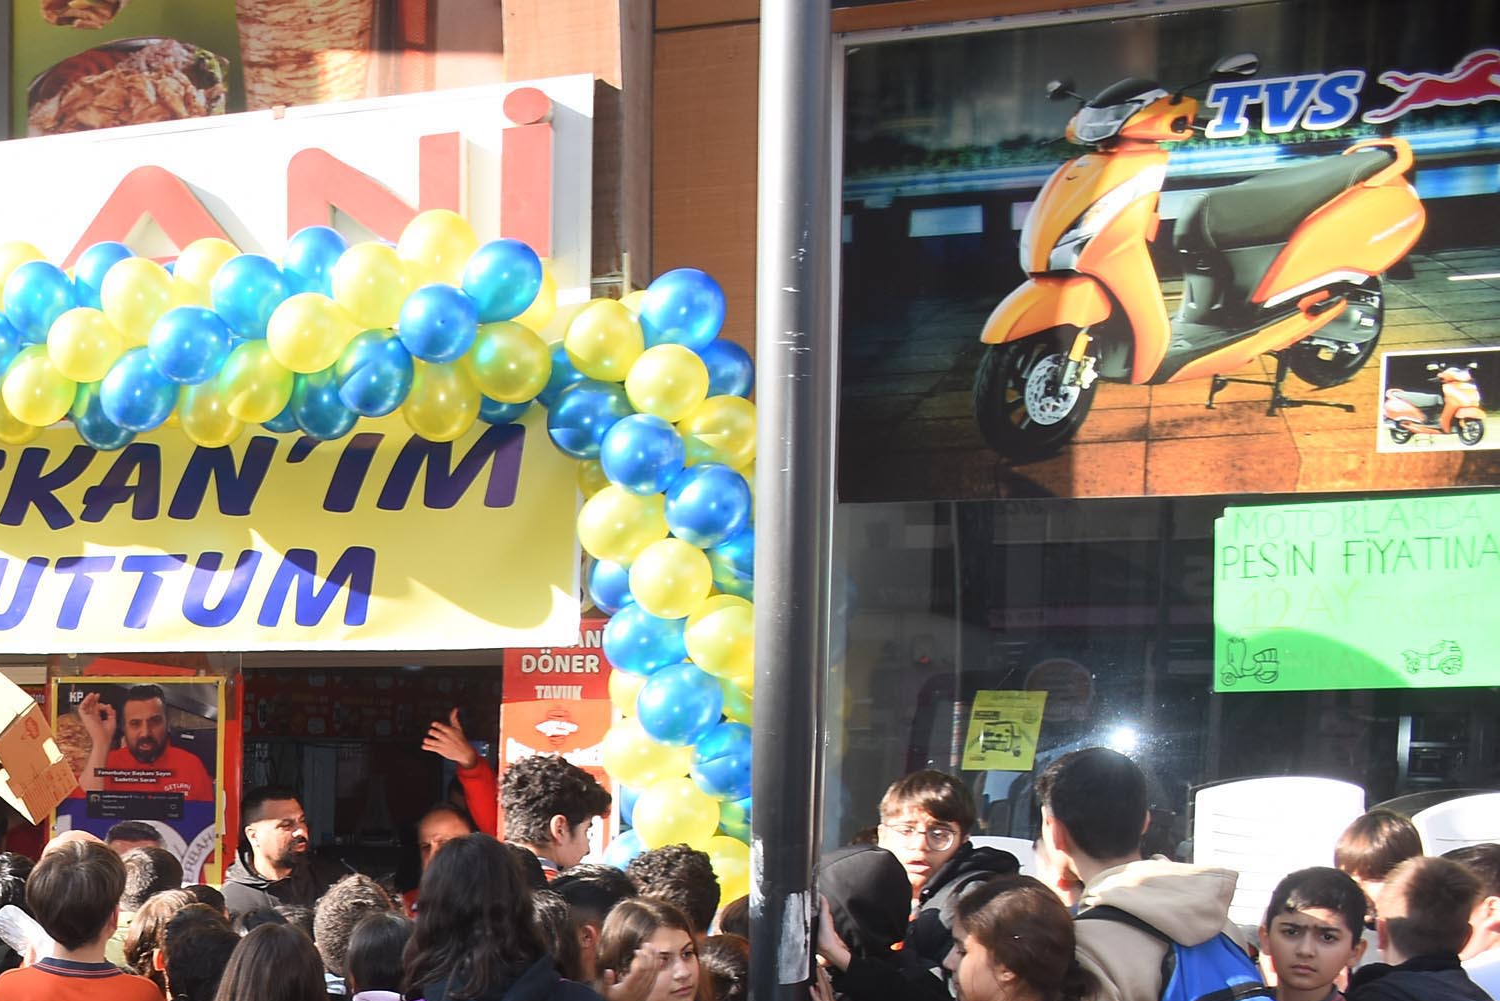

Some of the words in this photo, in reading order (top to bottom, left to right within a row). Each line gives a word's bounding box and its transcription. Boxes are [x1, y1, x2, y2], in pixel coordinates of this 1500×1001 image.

[1206, 71, 1364, 138] TVS
[1244, 586, 1295, 630] 12
[1300, 579, 1361, 625] AY
[521, 648, 600, 673] DÖNER
[534, 685, 583, 700] TAVUK
